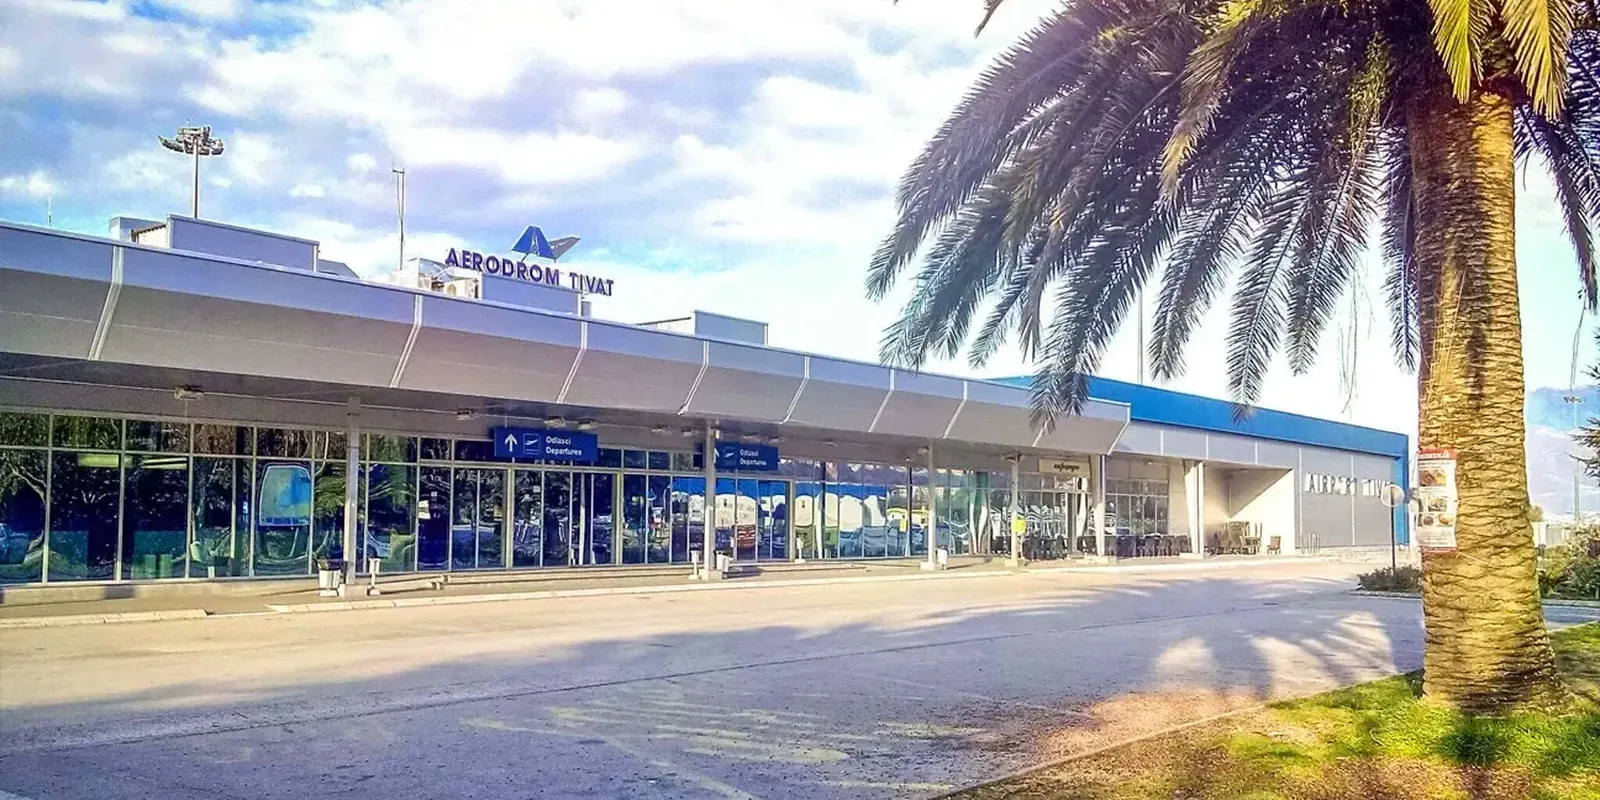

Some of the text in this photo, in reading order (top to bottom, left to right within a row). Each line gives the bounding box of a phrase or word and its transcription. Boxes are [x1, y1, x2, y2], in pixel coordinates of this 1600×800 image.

[445, 247, 615, 297] AERODROM TIVAT
[545, 435, 571, 445] Odlasci
[545, 446, 582, 456] Departures
